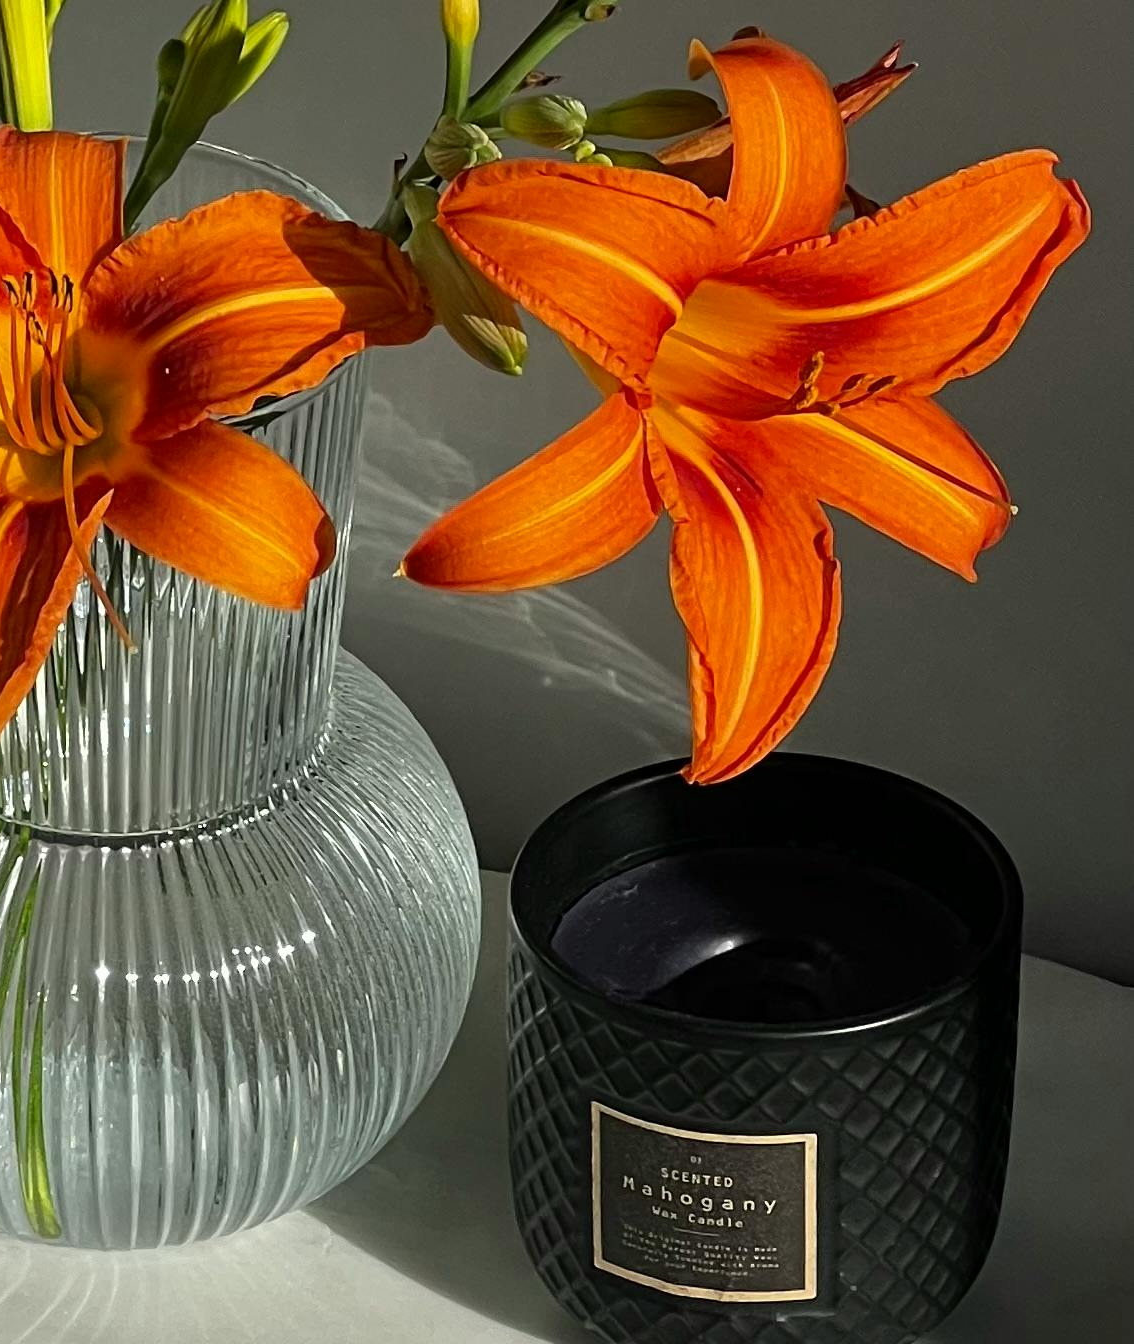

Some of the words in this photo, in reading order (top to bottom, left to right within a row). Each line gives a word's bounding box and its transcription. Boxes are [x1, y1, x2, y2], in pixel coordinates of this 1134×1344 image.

[660, 1167, 734, 1188] SCENTED
[622, 1175, 777, 1215] Mahogany
[651, 1205, 678, 1220] Wax
[687, 1213, 744, 1228] Candle
